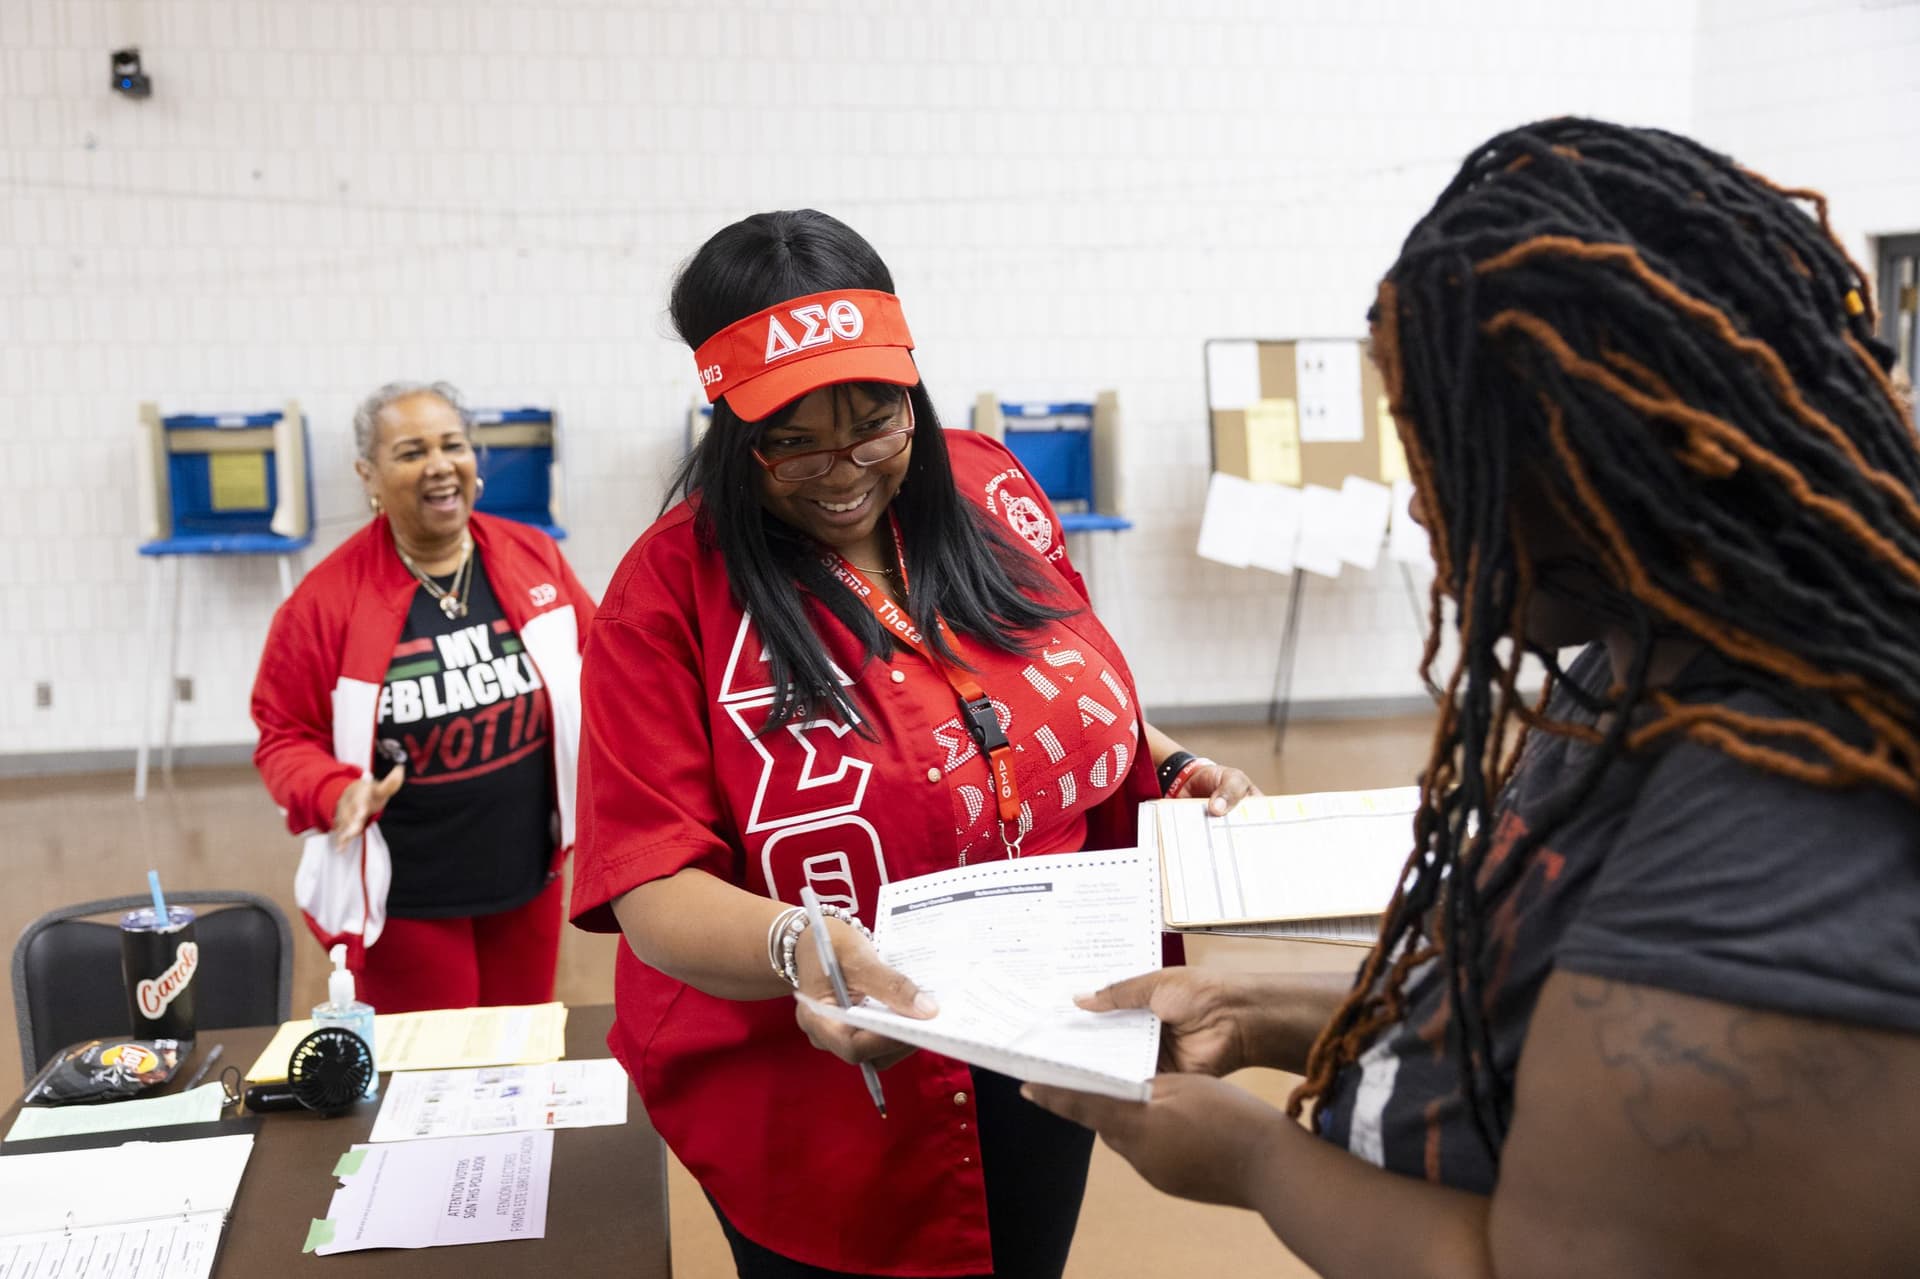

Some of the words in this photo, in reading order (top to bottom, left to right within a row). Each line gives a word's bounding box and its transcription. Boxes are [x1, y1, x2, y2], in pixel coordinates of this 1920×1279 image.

[764, 299, 864, 364] ΔΣΘ
[822, 552, 872, 598] Sigma
[878, 599, 923, 644] Theta
[436, 624, 493, 669] MY
[998, 759, 1012, 799] ΔΣΘ
[455, 1158, 471, 1181] VOTERS
[470, 1171, 483, 1188] POLL
[448, 1182, 464, 1217] ATTENTION
[464, 1203, 477, 1219] SIGN
[466, 1188, 480, 1203] THIS
